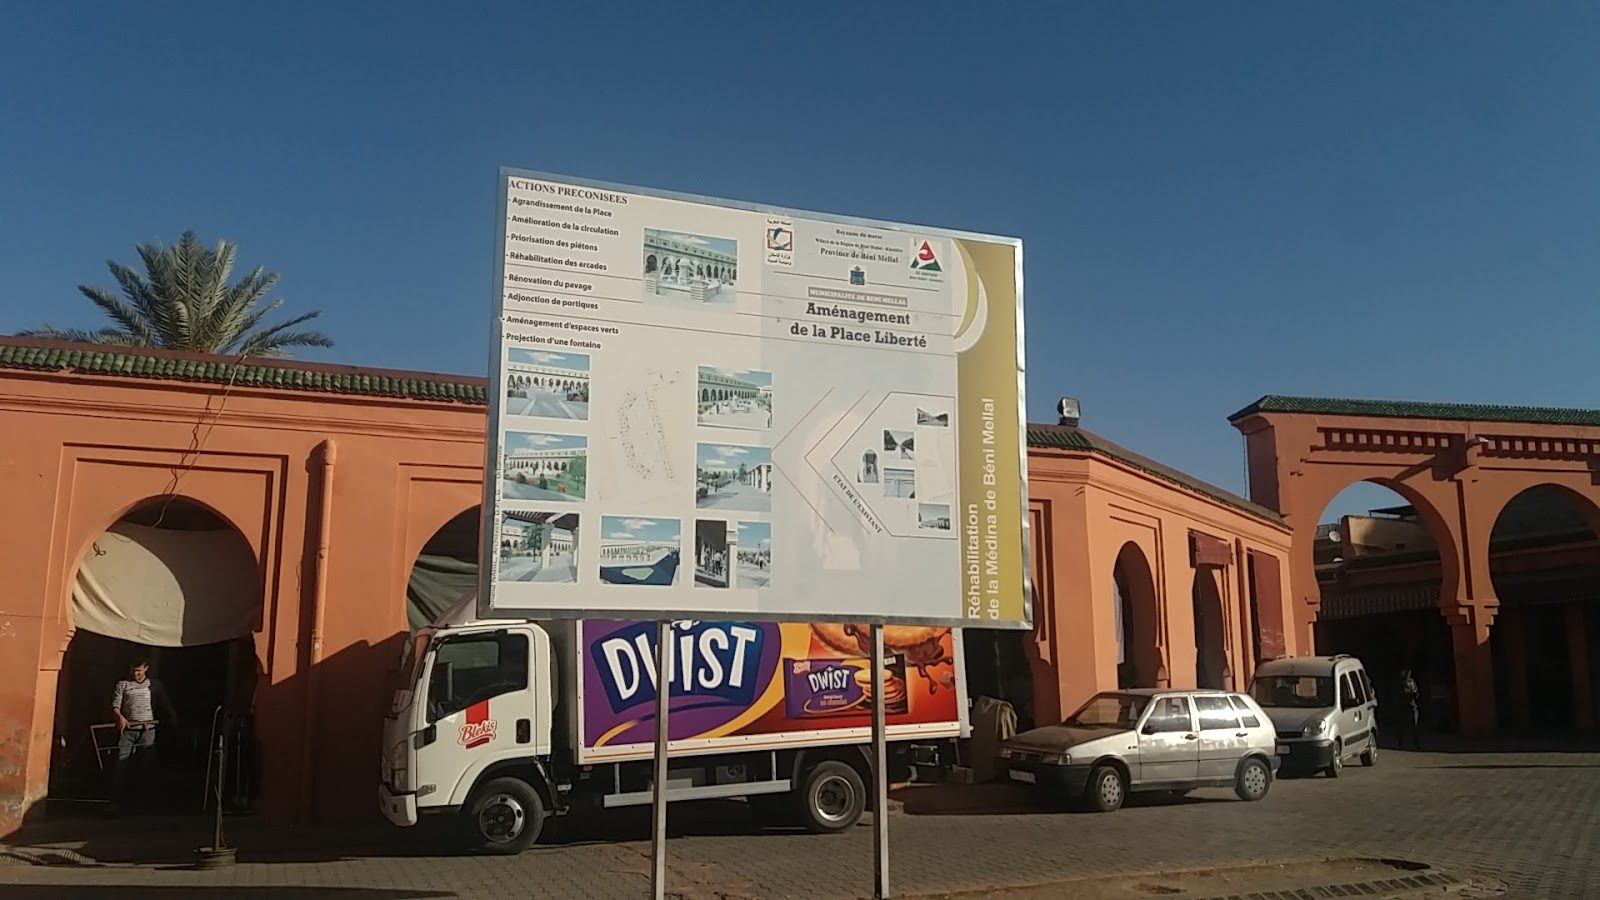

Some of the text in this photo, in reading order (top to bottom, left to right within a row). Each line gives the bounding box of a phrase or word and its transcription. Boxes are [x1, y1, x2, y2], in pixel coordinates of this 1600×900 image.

[508, 180, 628, 204] ACTIONS PRECONISEES
[512, 196, 612, 218] Agrandissement de la Place
[511, 215, 619, 236] Amélioration de la circulation
[510, 233, 598, 252] Priorisation des piétons
[510, 251, 608, 271] Réhabilitation des arcades
[820, 247, 899, 263] Province de Béni Mellal
[508, 273, 592, 291] Rénovation du pavage
[508, 292, 599, 310] Adjonction de portiques
[806, 302, 911, 325] Aménagement
[507, 315, 619, 334] Aménagement d'espaces verts
[790, 322, 927, 348] de la Place Liberté
[506, 332, 601, 349] Projection d'une fontaine
[833, 474, 847, 491] ETAT
[852, 498, 882, 533] L'EXISTANT
[981, 398, 999, 620] de la Médina de Béni Mellal
[966, 503, 981, 619] Réhabilitation
[460, 720, 495, 742] Blekis
